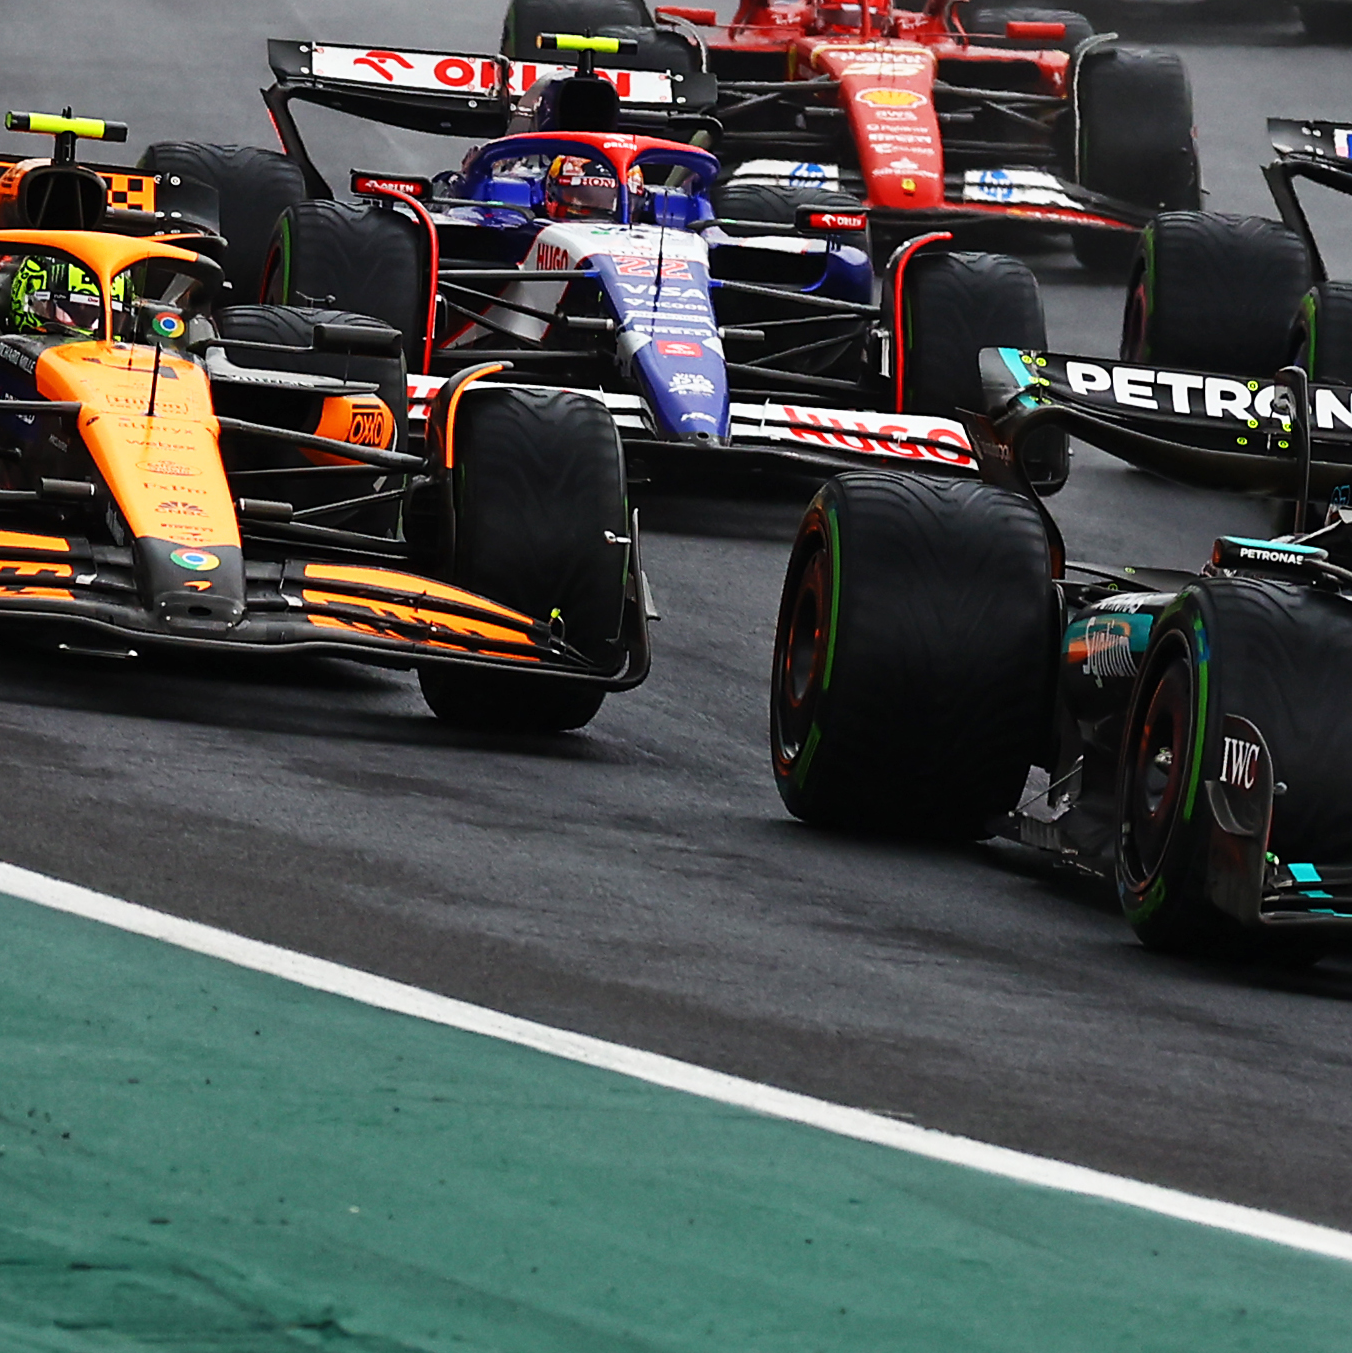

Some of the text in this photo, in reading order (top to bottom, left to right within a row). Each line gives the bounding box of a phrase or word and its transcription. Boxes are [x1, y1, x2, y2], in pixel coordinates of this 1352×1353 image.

[579, 177, 616, 189] HON
[536, 242, 570, 271] HUGO
[612, 255, 694, 281] 22
[616, 282, 707, 300] VISA
[118, 421, 194, 435] alteryx
[782, 404, 972, 467] HUGO
[125, 438, 196, 451] webex
[1240, 548, 1305, 566] PETRONAS
[1220, 736, 1261, 790] IWC
